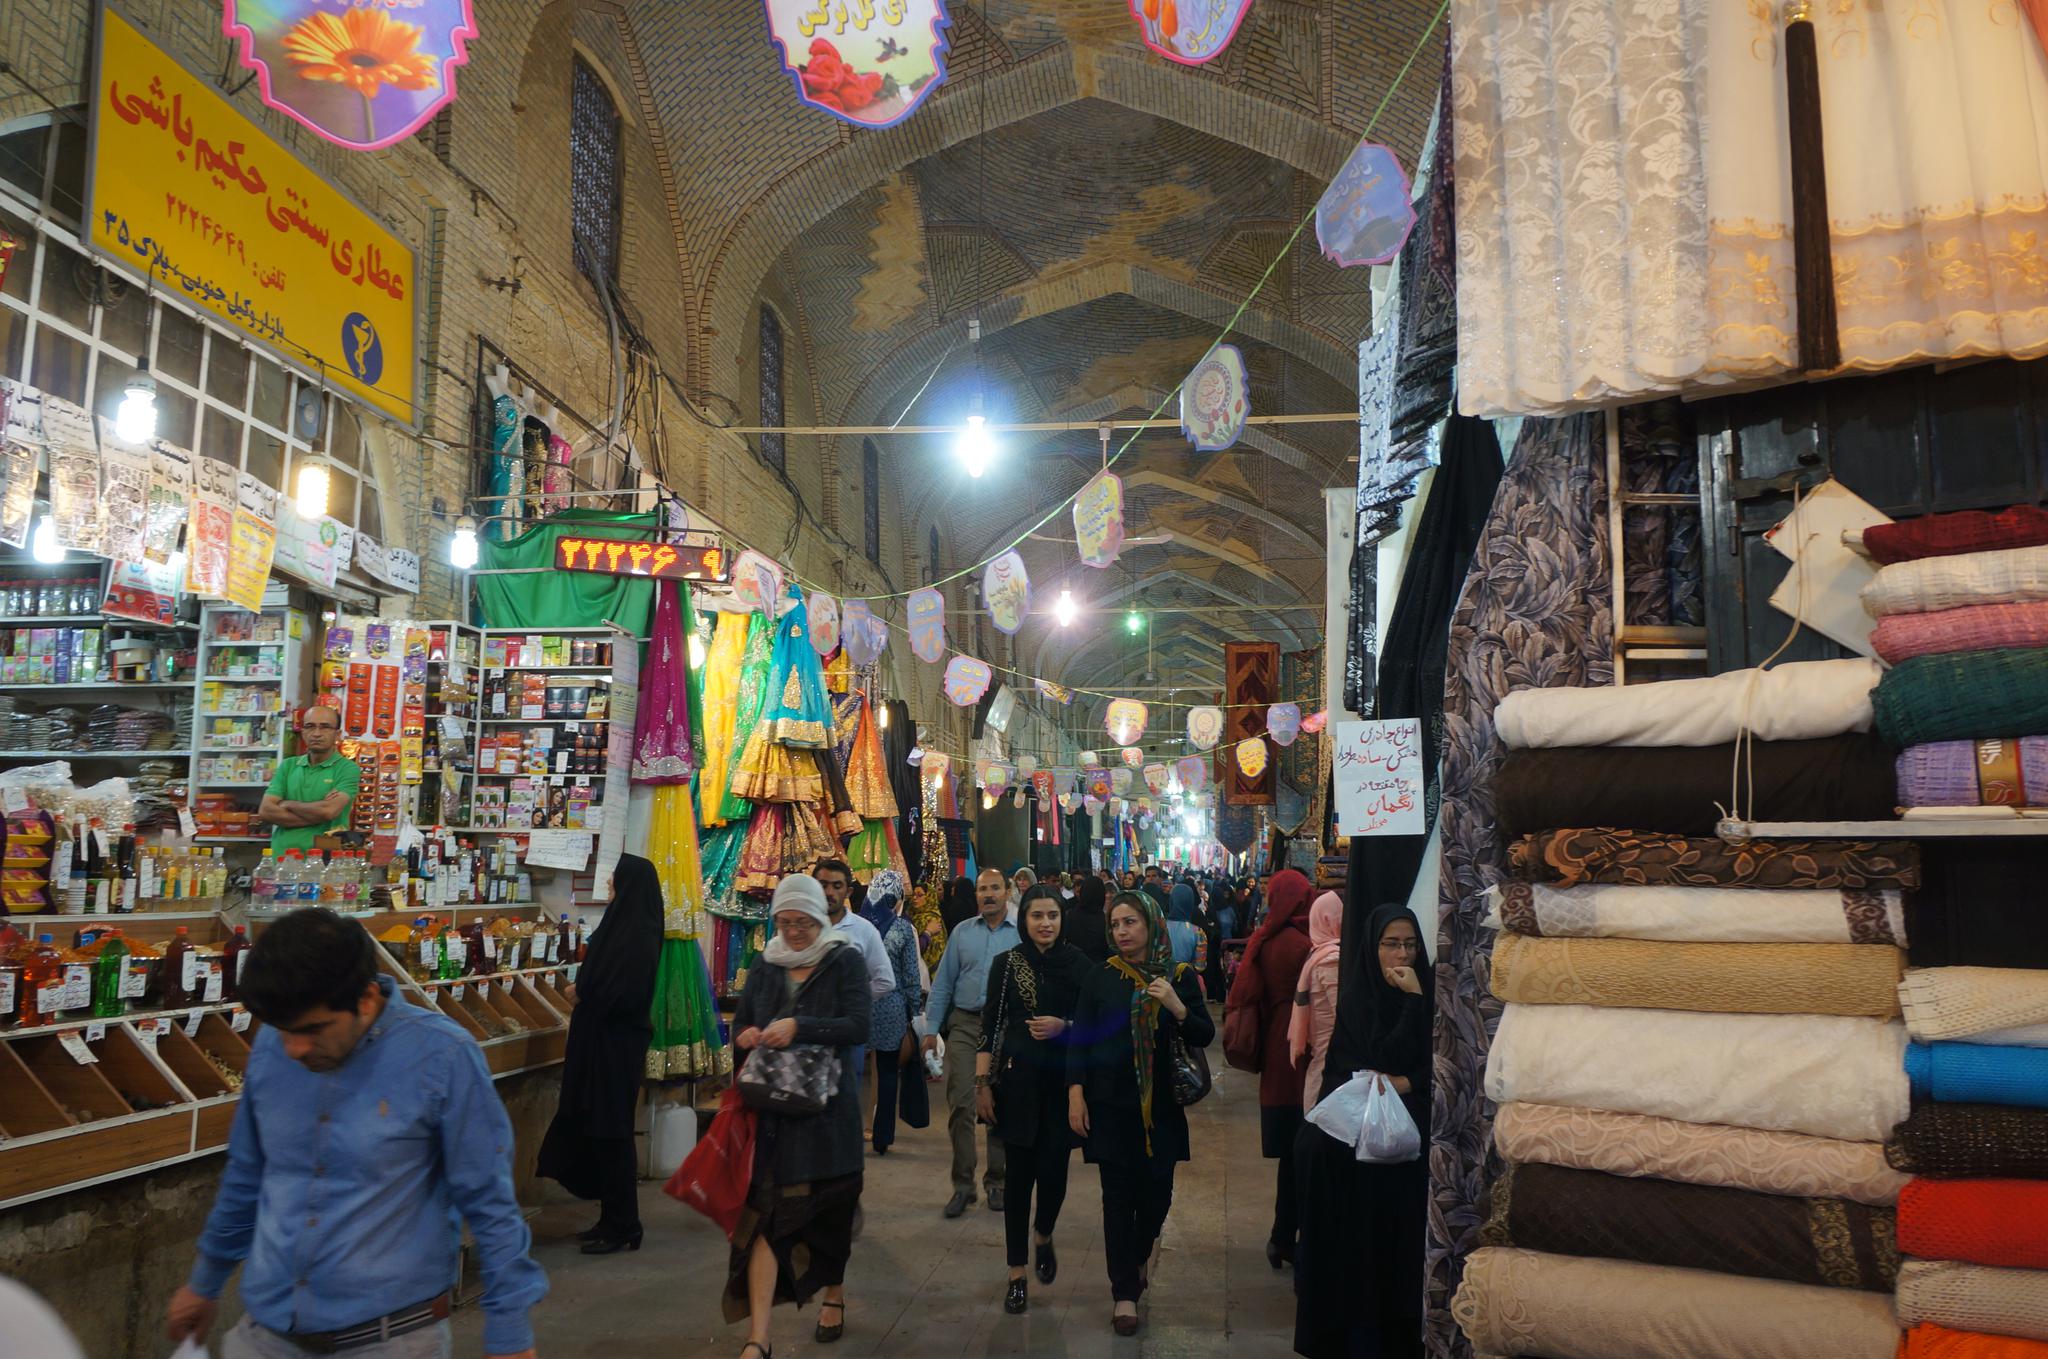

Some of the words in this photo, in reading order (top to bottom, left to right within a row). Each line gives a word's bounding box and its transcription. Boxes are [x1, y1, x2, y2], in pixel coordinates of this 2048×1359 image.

[109, 75, 194, 163] باشی
[194, 140, 268, 196] حکیم
[104, 208, 131, 246] ۳۵
[166, 191, 246, 267] ۲۲۲۴۶۴۹
[265, 187, 330, 250] سنتی
[330, 243, 405, 301] عطاری
[226, 291, 256, 329] وکیل
[256, 311, 285, 344] بازار
[1393, 723, 1418, 747] انواع
